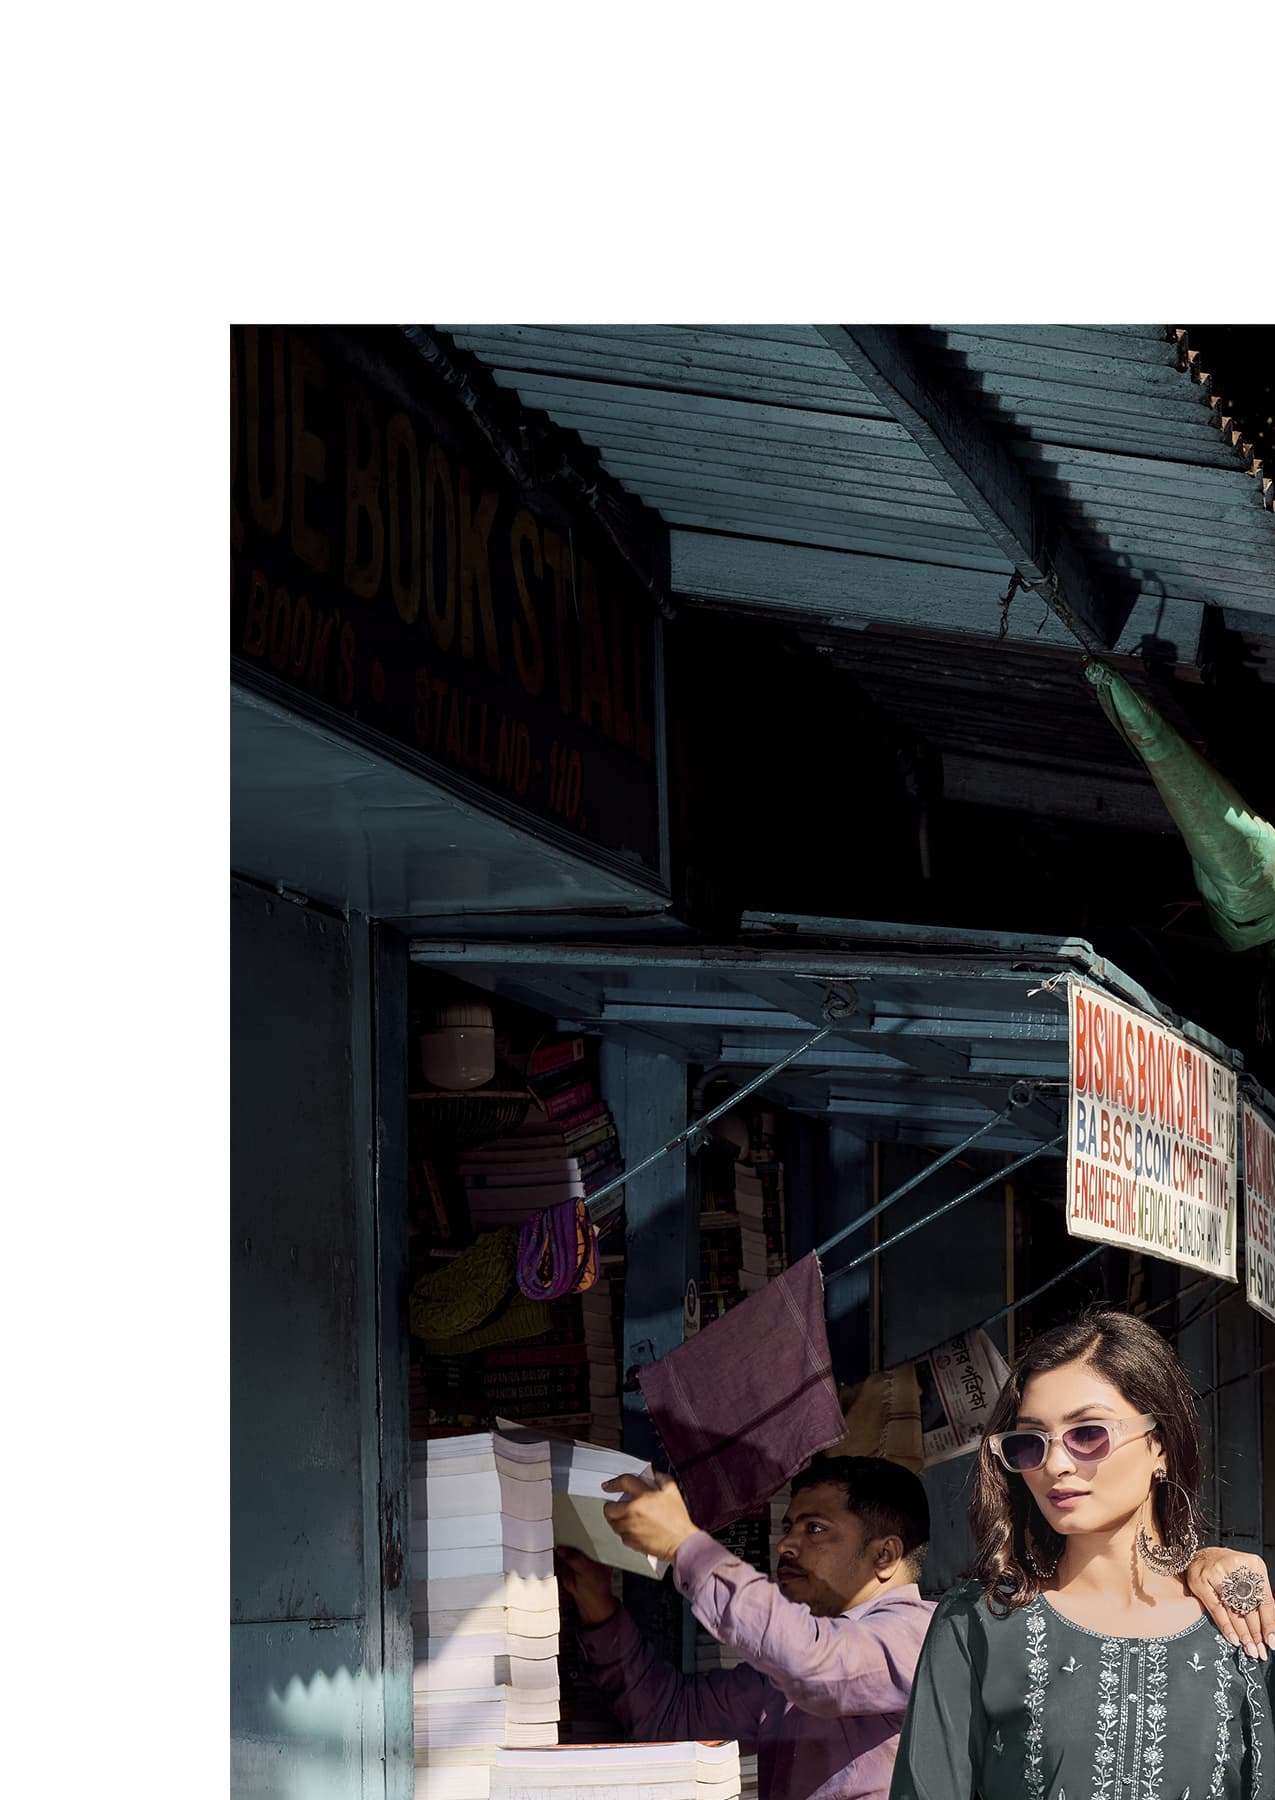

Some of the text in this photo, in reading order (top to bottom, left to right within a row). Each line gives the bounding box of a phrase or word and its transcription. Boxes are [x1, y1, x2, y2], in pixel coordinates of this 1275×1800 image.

[1076, 995, 1135, 1113] BISWAS
[1136, 1024, 1175, 1128] BOOK
[1177, 1045, 1210, 1146] STALL
[1074, 1158, 1136, 1237] ENGINEERING
[1137, 1183, 1172, 1249] MEDICAL
[1173, 1141, 1228, 1211] COMPETITIVE
